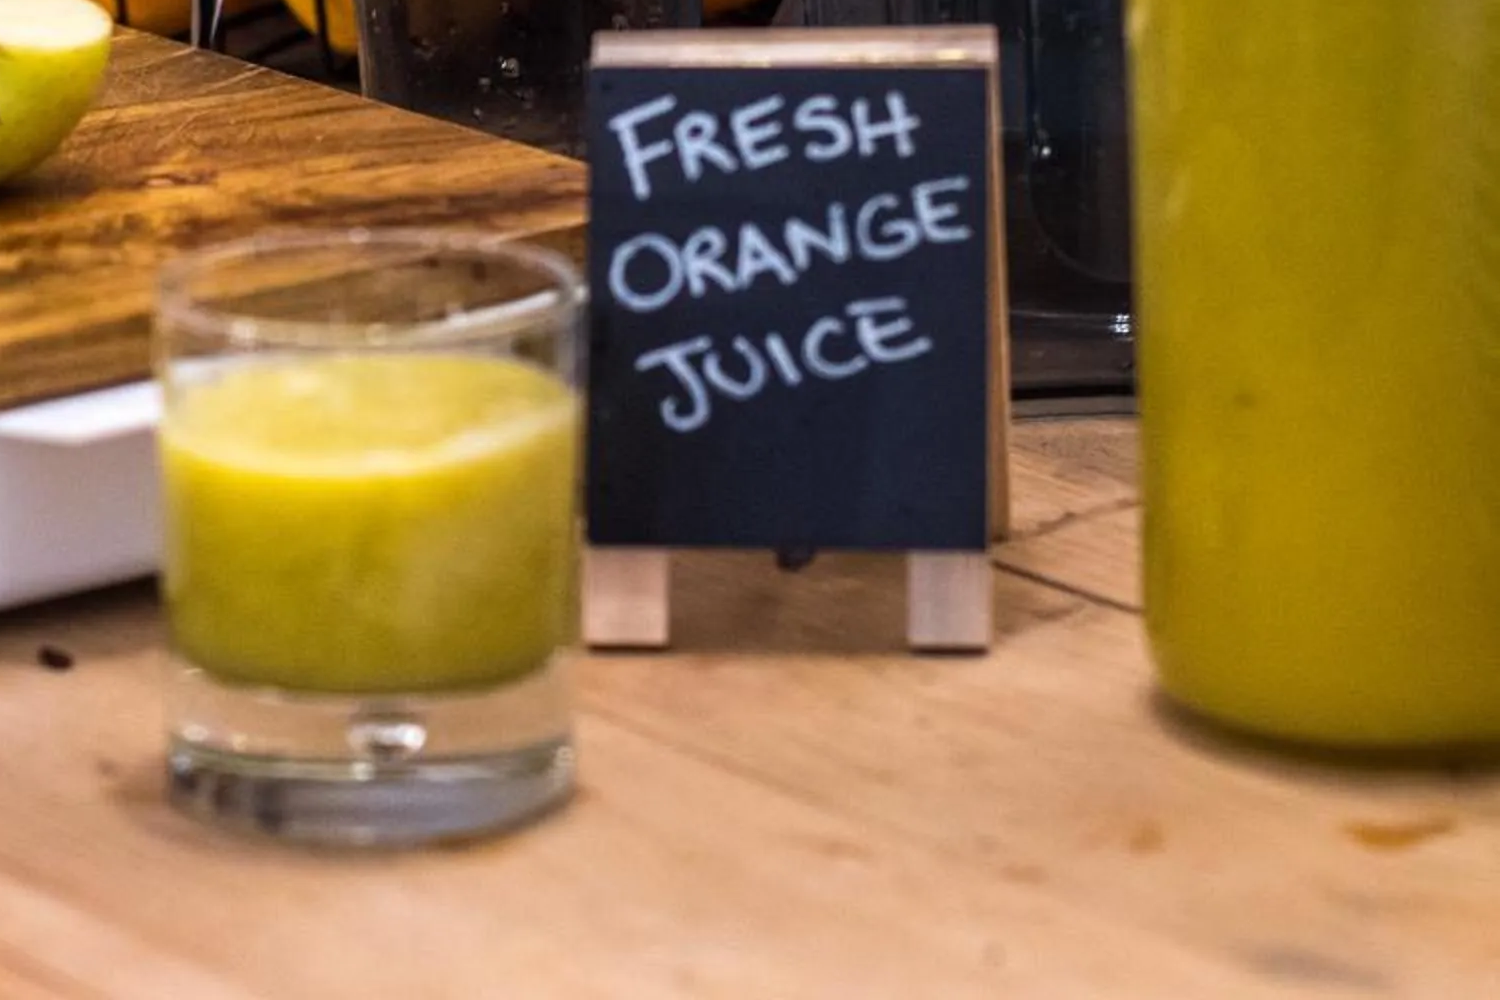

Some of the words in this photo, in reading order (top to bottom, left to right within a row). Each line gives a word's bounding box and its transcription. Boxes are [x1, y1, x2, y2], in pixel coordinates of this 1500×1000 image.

[609, 91, 920, 200] FRESH
[609, 176, 971, 311] ORANGE
[635, 297, 932, 432] JUICE
